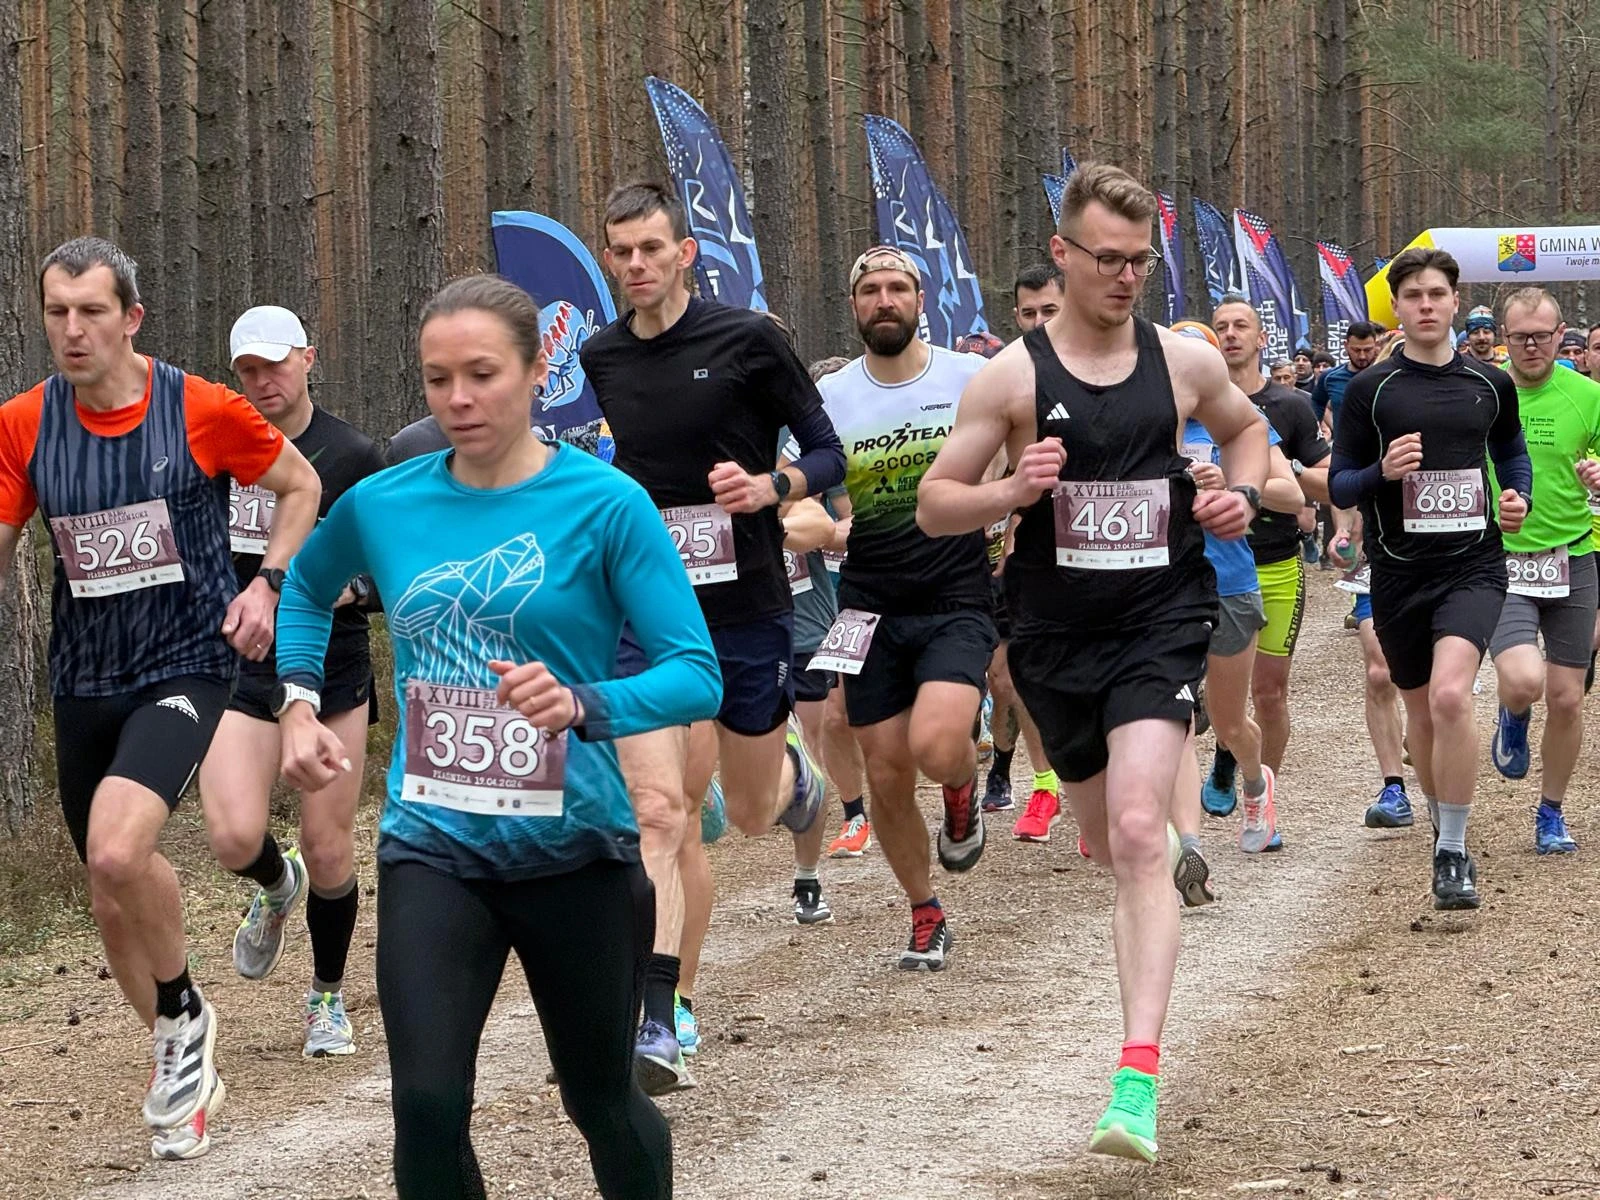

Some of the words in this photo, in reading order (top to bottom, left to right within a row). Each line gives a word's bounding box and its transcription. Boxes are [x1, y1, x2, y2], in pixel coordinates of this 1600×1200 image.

[1540, 238, 1587, 252] GMINA
[1566, 256, 1590, 267] Twoje
[920, 403, 952, 411] VERGE
[1417, 473, 1447, 482] XVIII
[1073, 485, 1115, 497] XVIII
[1416, 483, 1474, 513] 685
[69, 513, 108, 530] XVIII
[1070, 499, 1154, 541] 461
[73, 520, 160, 571] 526
[667, 521, 716, 560] 25
[1506, 557, 1559, 582] 386
[428, 686, 480, 708] XVIII
[425, 710, 539, 777] 358
